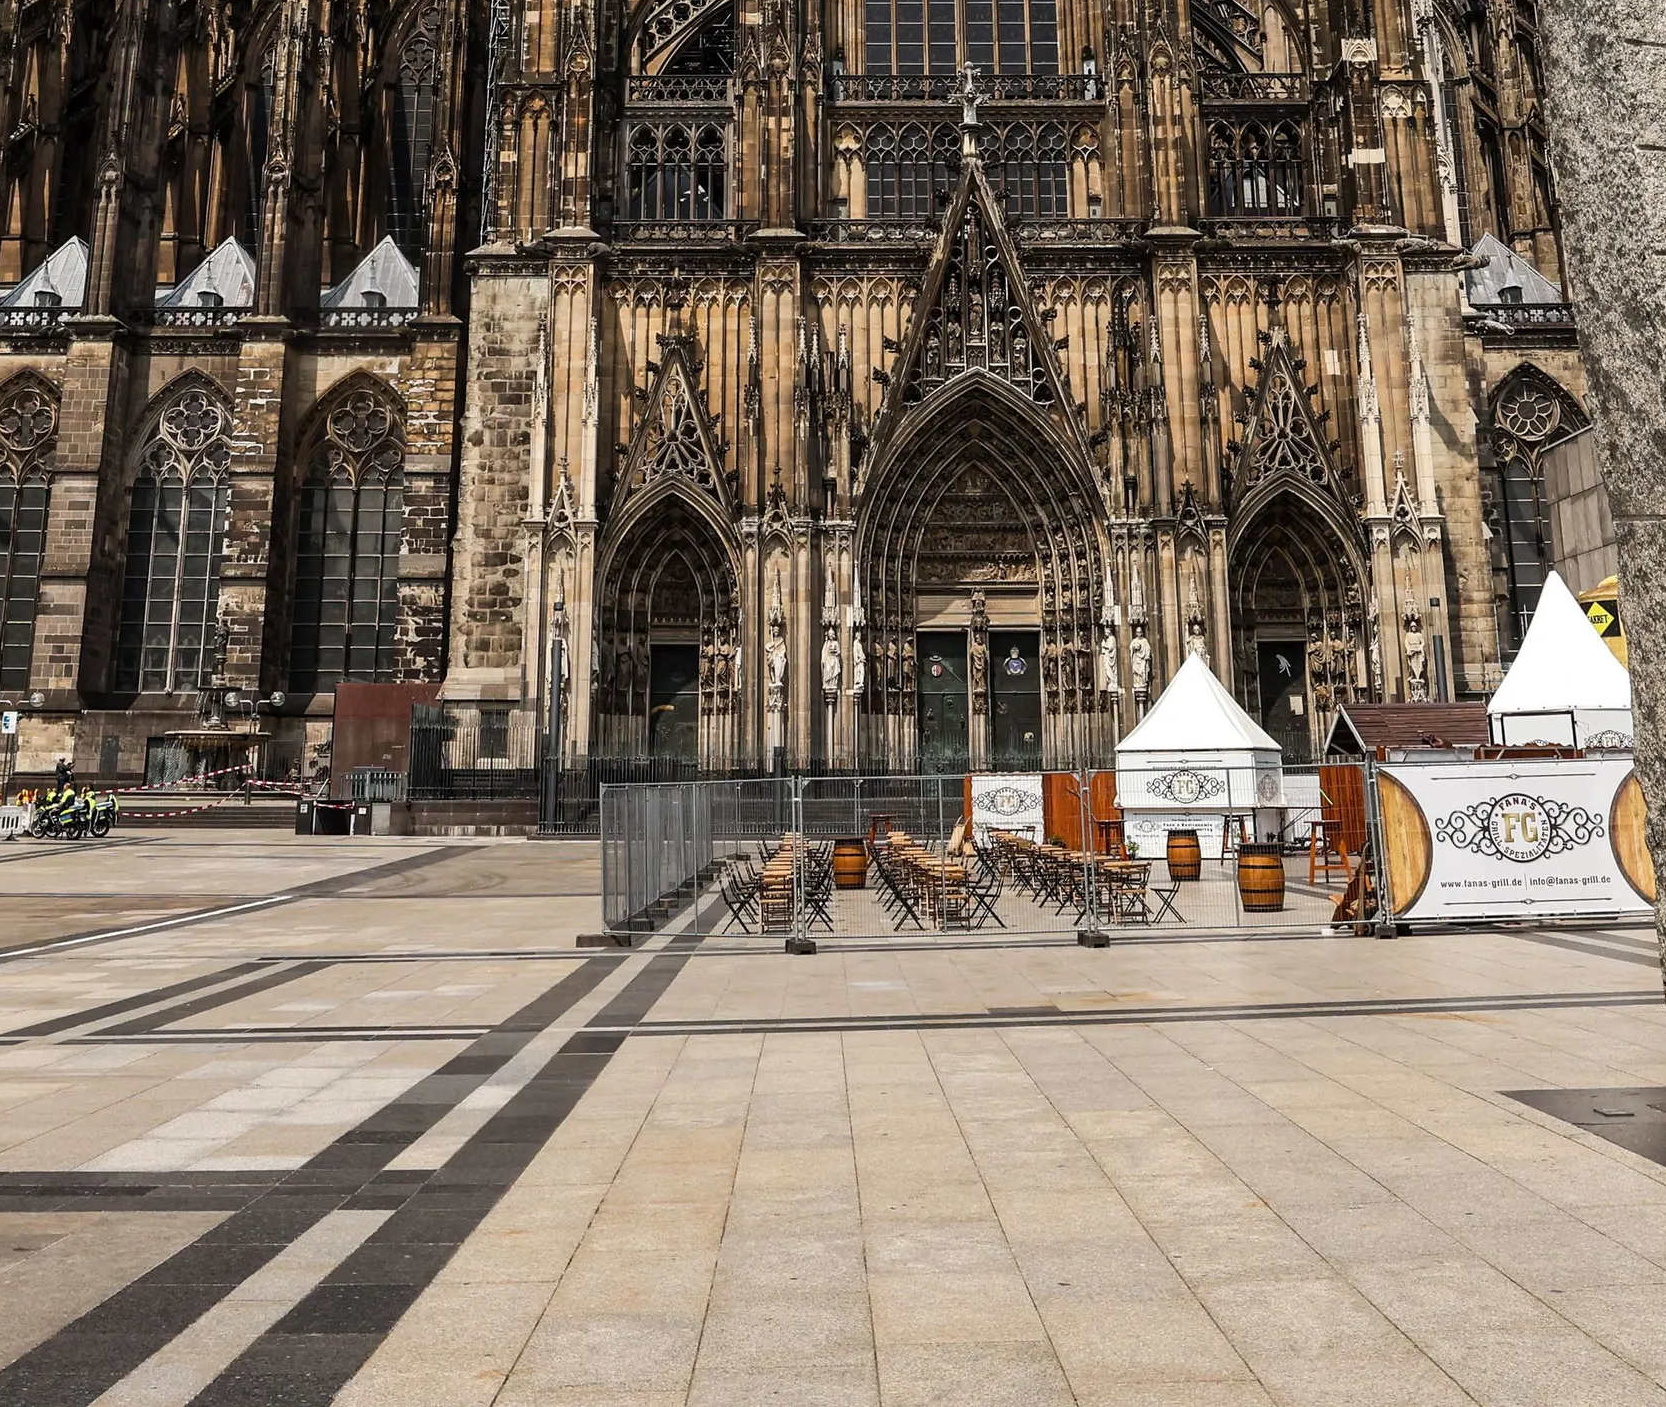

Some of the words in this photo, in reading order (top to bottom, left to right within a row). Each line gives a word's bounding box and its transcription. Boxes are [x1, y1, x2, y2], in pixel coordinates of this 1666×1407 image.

[1499, 797, 1537, 811] FANA'S
[1501, 812, 1539, 844] FG
[1440, 878, 1523, 889] www.fanas-grill.de
[1529, 875, 1612, 888] info@fanas-grill.de
